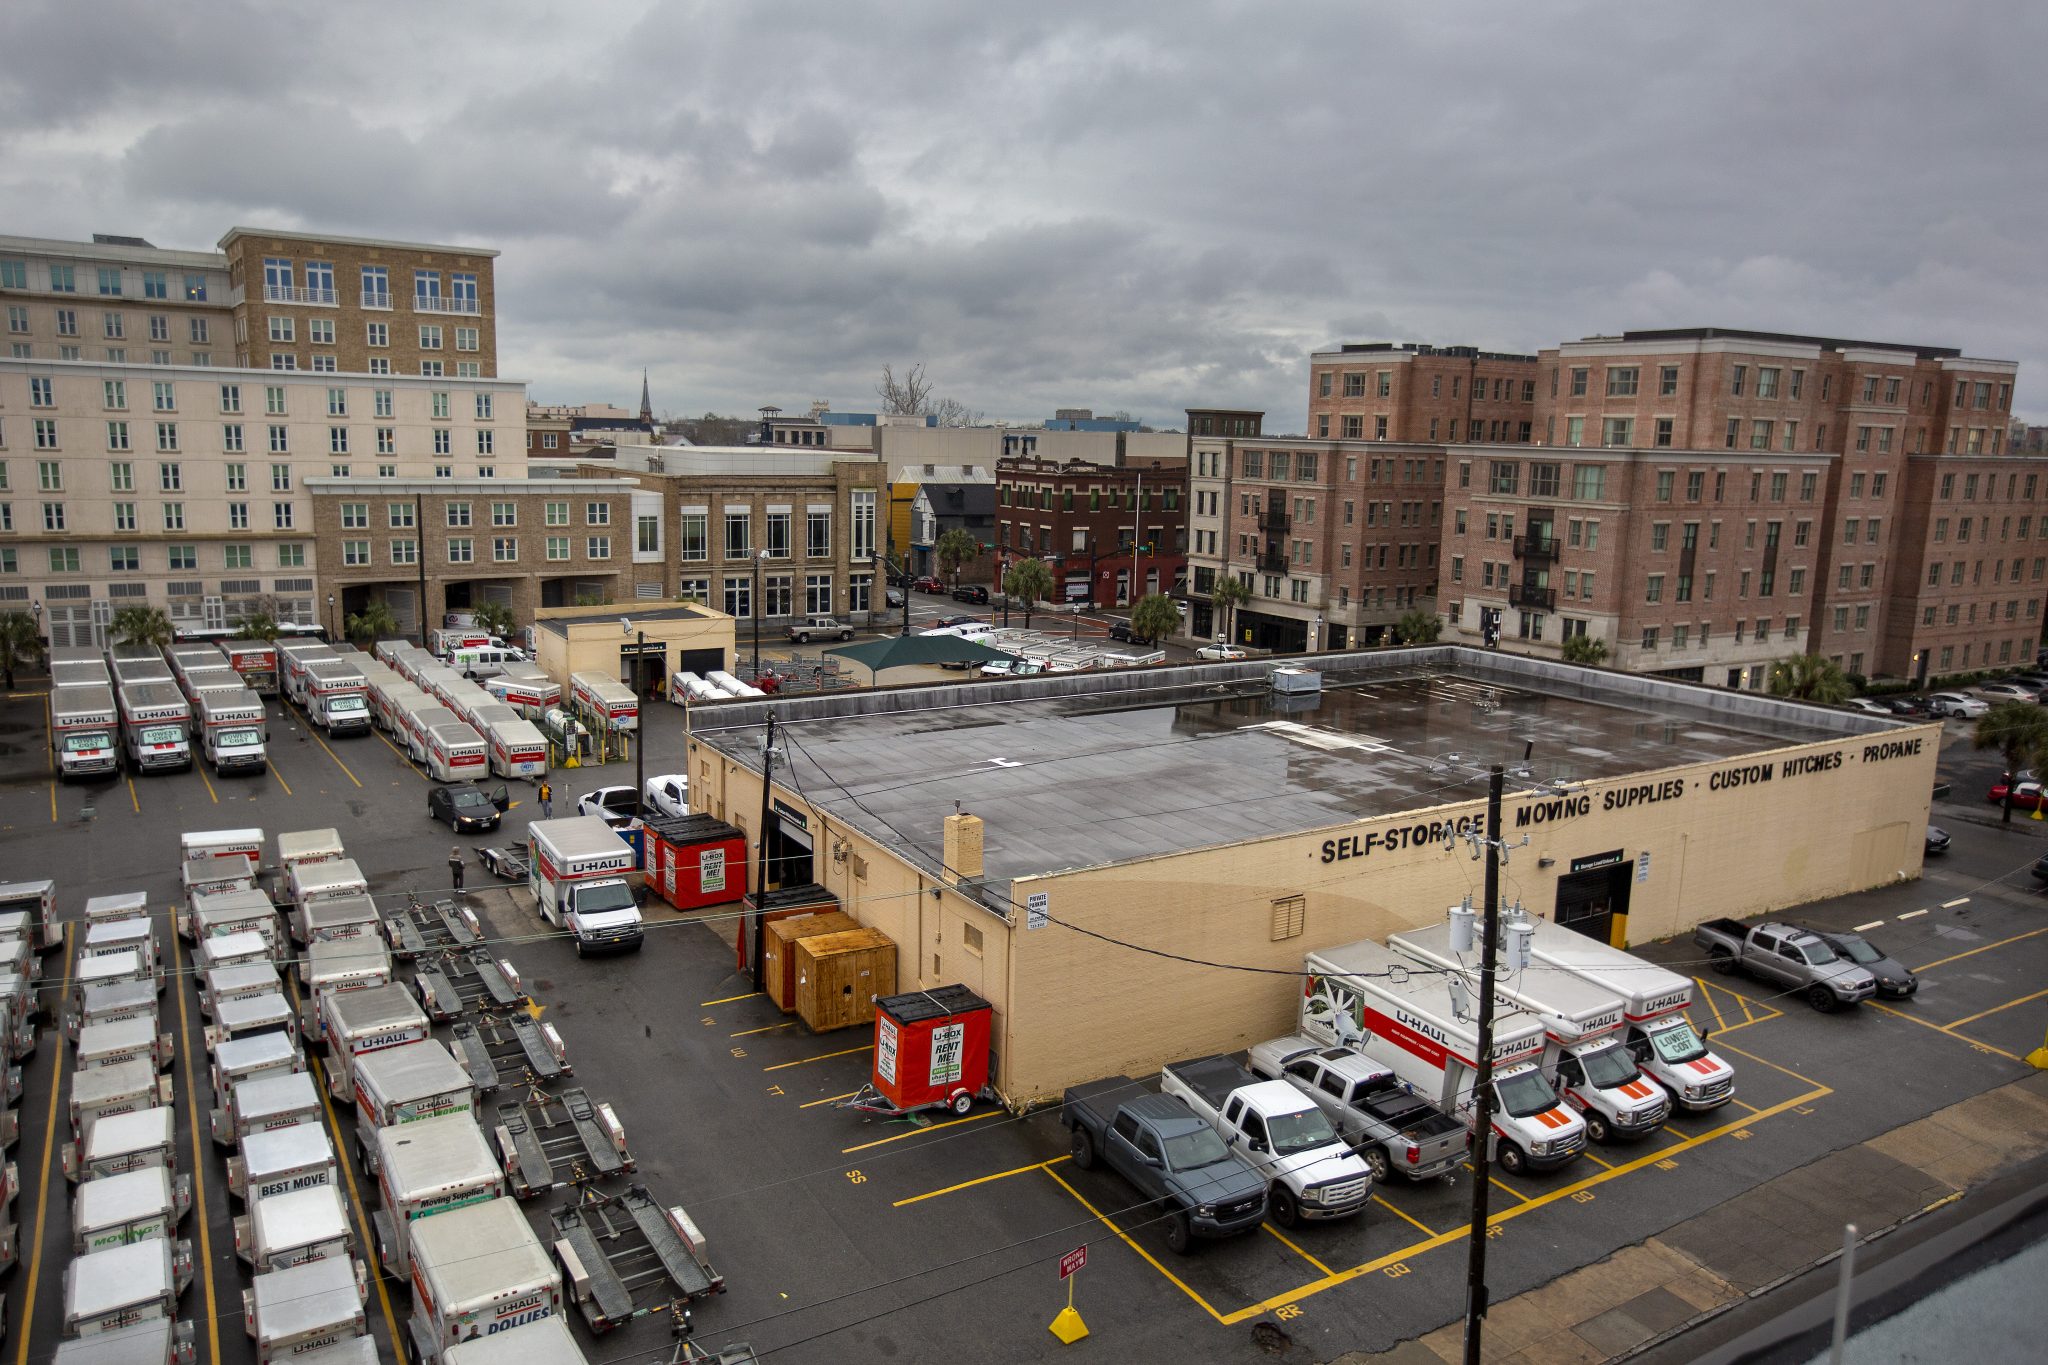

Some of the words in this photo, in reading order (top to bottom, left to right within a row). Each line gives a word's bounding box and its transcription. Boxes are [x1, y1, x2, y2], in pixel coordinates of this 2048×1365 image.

[325, 681, 361, 689] U-HAUL
[516, 690, 539, 698] U-HAUL
[62, 716, 109, 725] U-HAUL
[138, 710, 182, 719] U-HAUL
[215, 712, 257, 721] U-HAUL
[147, 730, 178, 738] LOWEST
[1321, 814, 1485, 863] SELF-STORAGE
[1516, 795, 1590, 827] MOVING
[1603, 779, 1684, 811] SUPPLIES
[1709, 764, 1773, 791] CUSTOM
[1782, 751, 1842, 778] HITCHES
[1863, 738, 1922, 763] PROPANE
[298, 856, 328, 865] MOVING?
[573, 859, 626, 872] U-HAUL
[329, 890, 356, 898] U-HAUL
[97, 945, 140, 957] MOVING?
[336, 981, 367, 989] U-HAUL
[1646, 993, 1686, 1011] U-HAUL
[106, 1013, 137, 1023] U-HAUL
[1396, 1010, 1448, 1045] U-HAUL
[362, 1032, 409, 1048] U-HAUL
[934, 1029, 962, 1040] U-BOX
[1659, 1029, 1689, 1047] LOWEST
[935, 1041, 960, 1054] RENT
[1492, 1037, 1538, 1059] U-HAUL
[1672, 1039, 1693, 1053] COST
[101, 1054, 135, 1065] U-HAUL
[937, 1052, 955, 1063] ME!
[766, 1085, 784, 1096] TT
[417, 1098, 452, 1110] U-HAUL
[98, 1105, 134, 1117] U-HAUL
[265, 1118, 299, 1128] U-HAUL
[846, 1169, 867, 1184] SS
[262, 1181, 290, 1197] BEST
[293, 1173, 325, 1189] MOVE
[421, 1197, 451, 1208] Moving
[452, 1188, 485, 1201] Supplies
[94, 1224, 160, 1246] MOVING?
[293, 1251, 325, 1264] U-HAUL
[1063, 1248, 1084, 1266] WRONG
[497, 1296, 541, 1314] U-HAUL
[1275, 1304, 1304, 1321] RR
[488, 1307, 550, 1335] DOLLIES
[293, 1336, 338, 1353] U-HAUL
